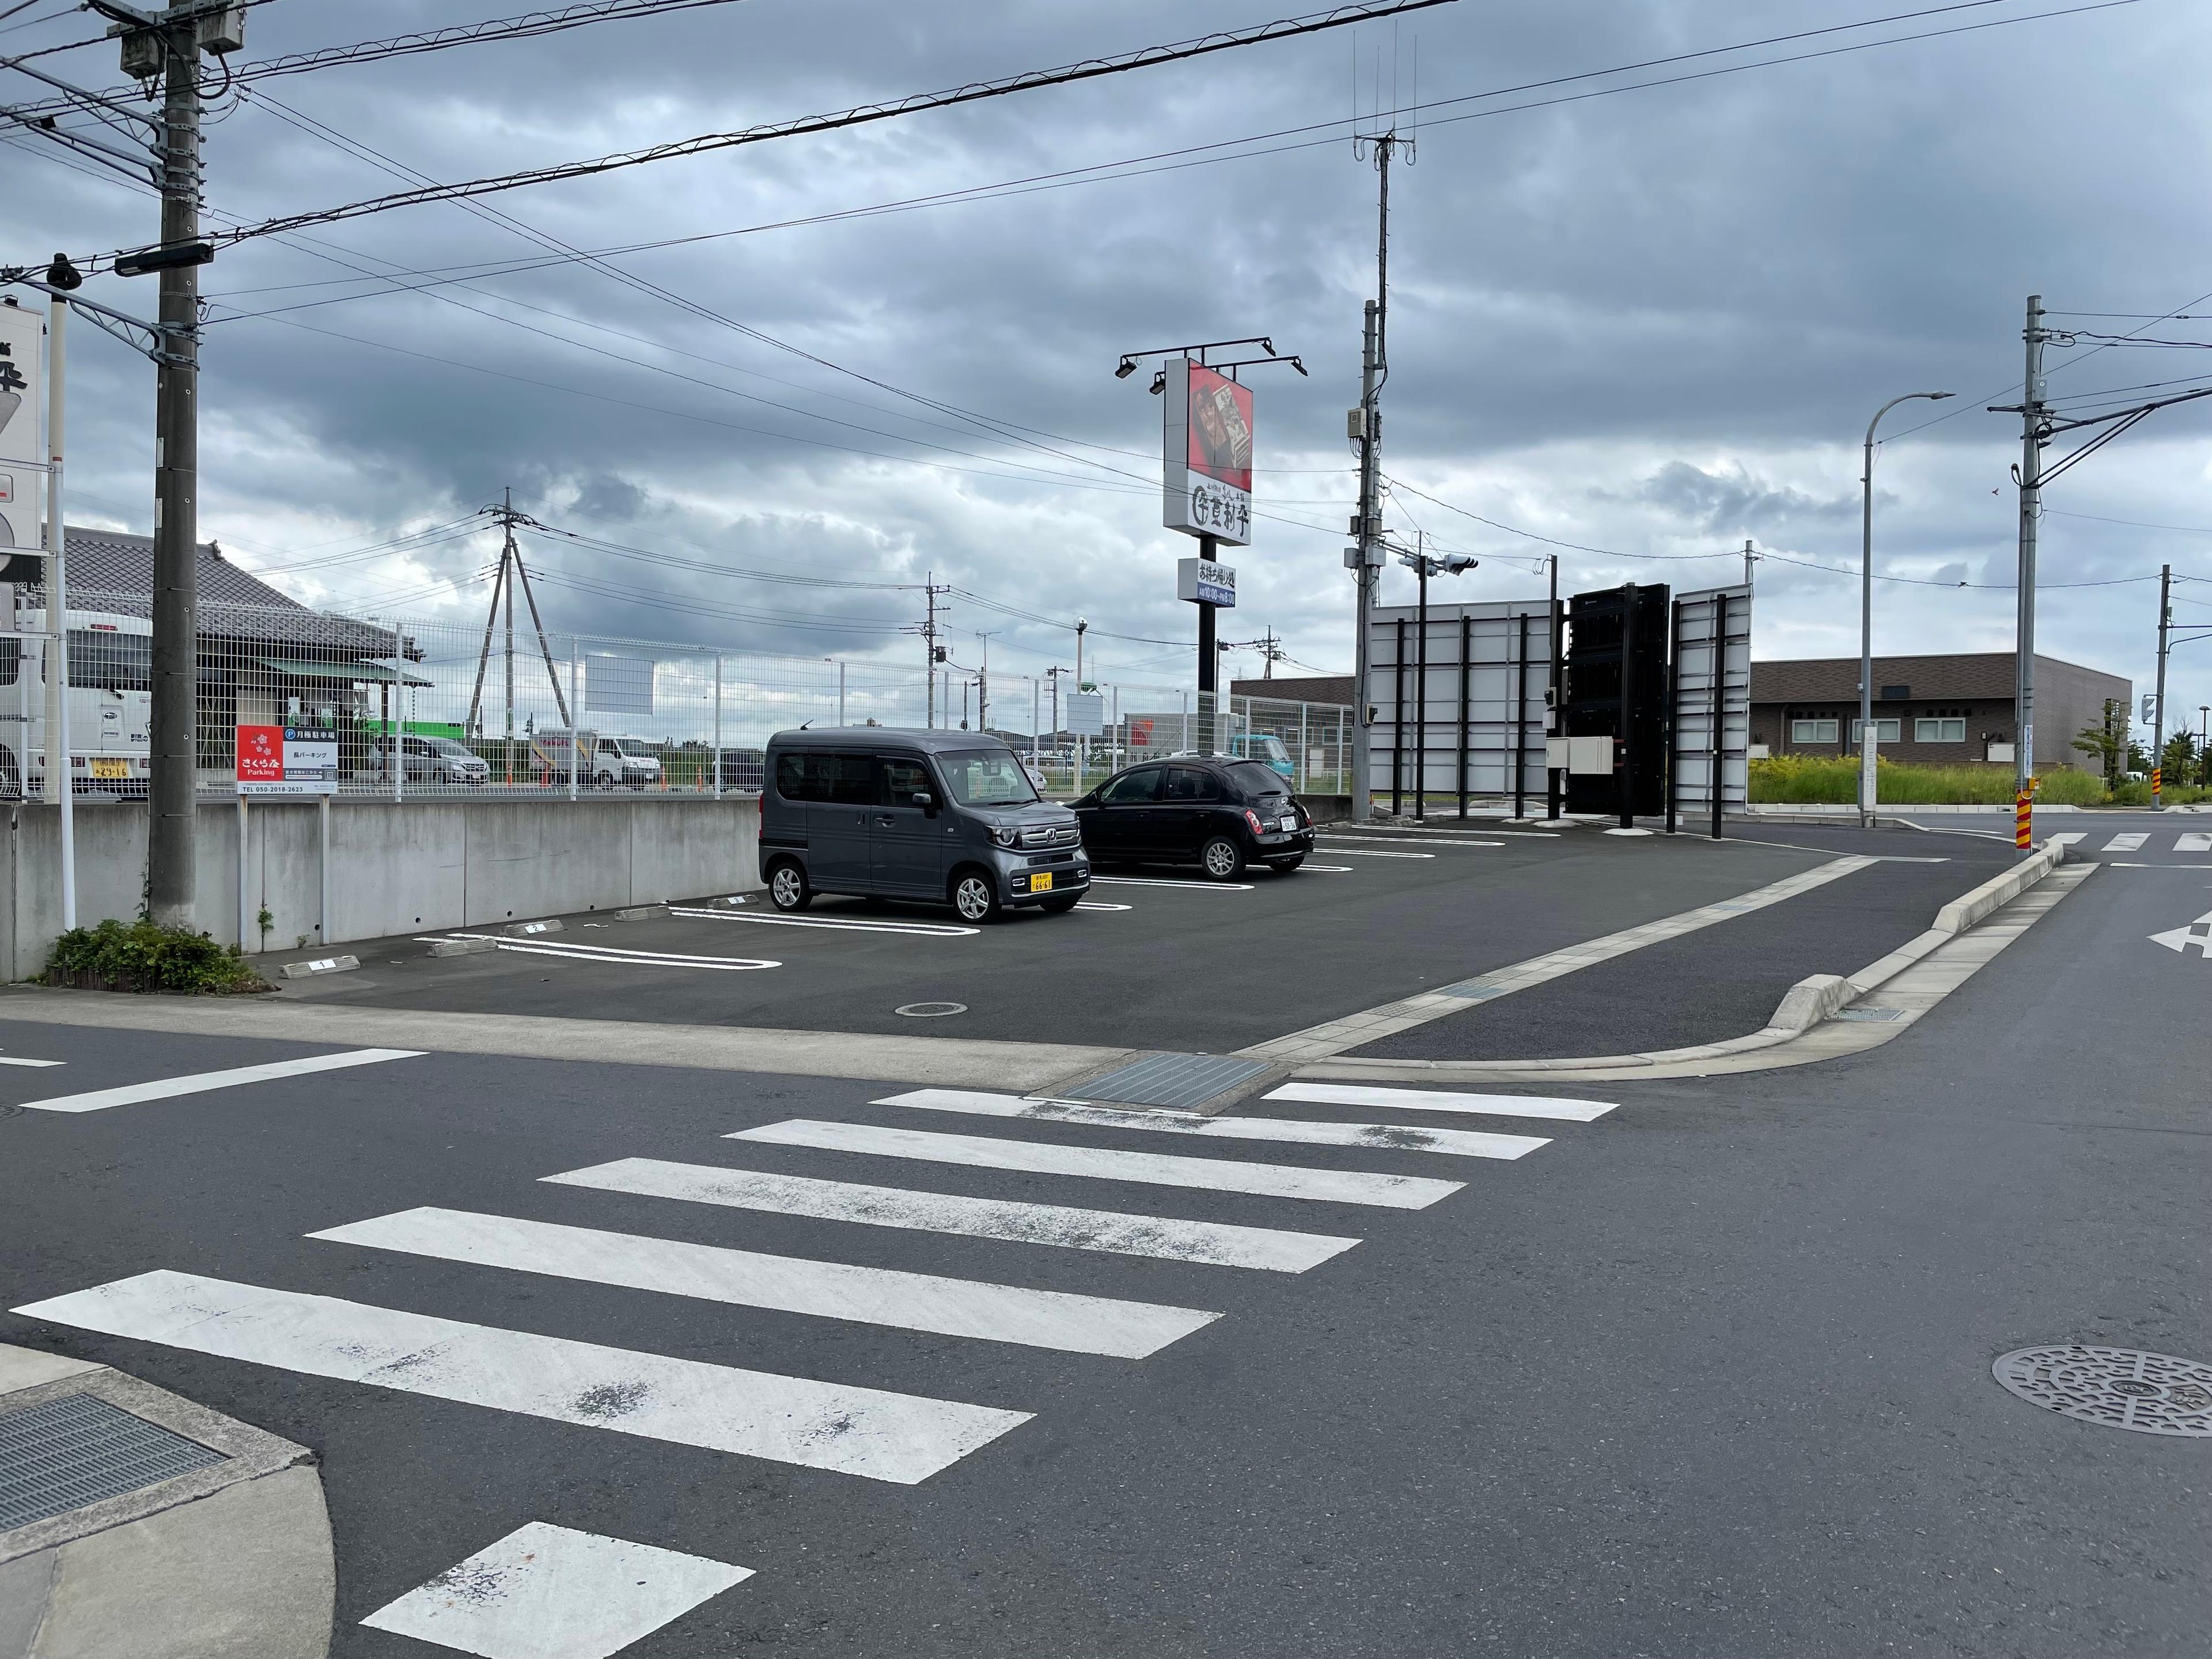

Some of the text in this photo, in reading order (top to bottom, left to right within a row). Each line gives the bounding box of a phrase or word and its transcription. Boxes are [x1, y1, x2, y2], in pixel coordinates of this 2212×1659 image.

[1199, 562, 1235, 589] お持ち帰り処
[297, 730, 335, 739] 月極駐車場
[1036, 880, 1051, 890] 66-61
